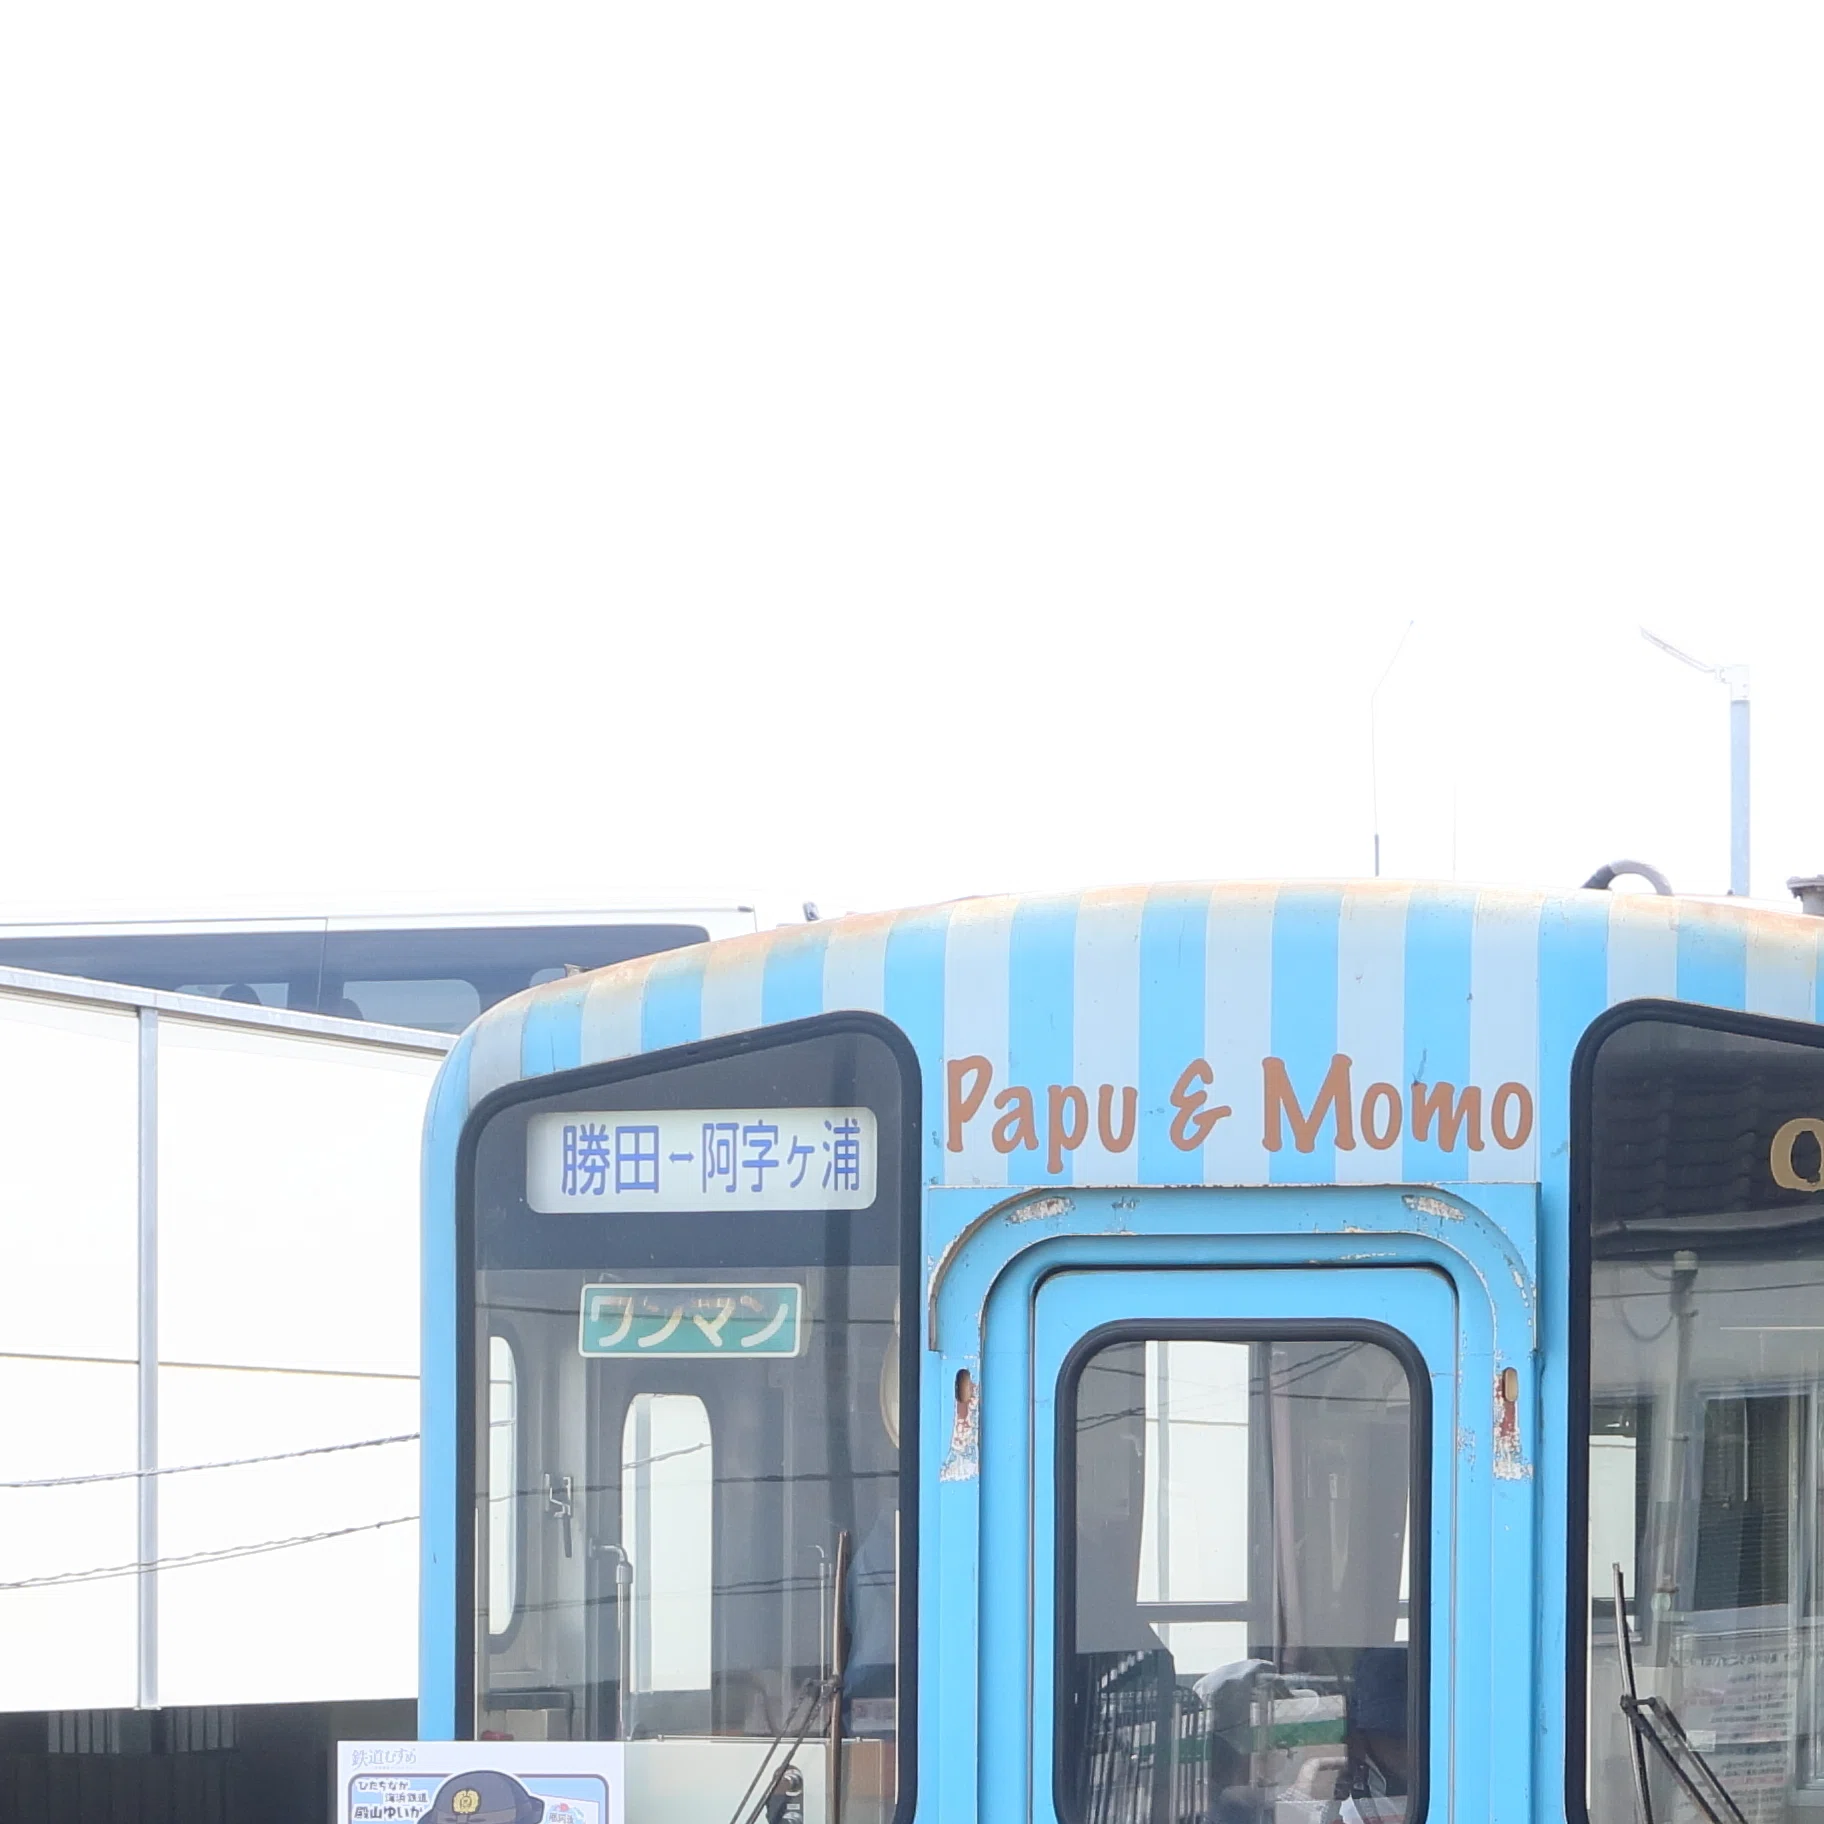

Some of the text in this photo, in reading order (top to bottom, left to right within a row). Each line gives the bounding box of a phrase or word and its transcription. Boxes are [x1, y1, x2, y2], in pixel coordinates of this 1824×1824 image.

[945, 1052, 1534, 1174] Papu & Momo
[561, 1123, 661, 1196] 勝田
[589, 1294, 790, 1349] ワンマン
[351, 1747, 417, 1770] 鉄道むすめ
[357, 1780, 409, 1793] ひたちなか
